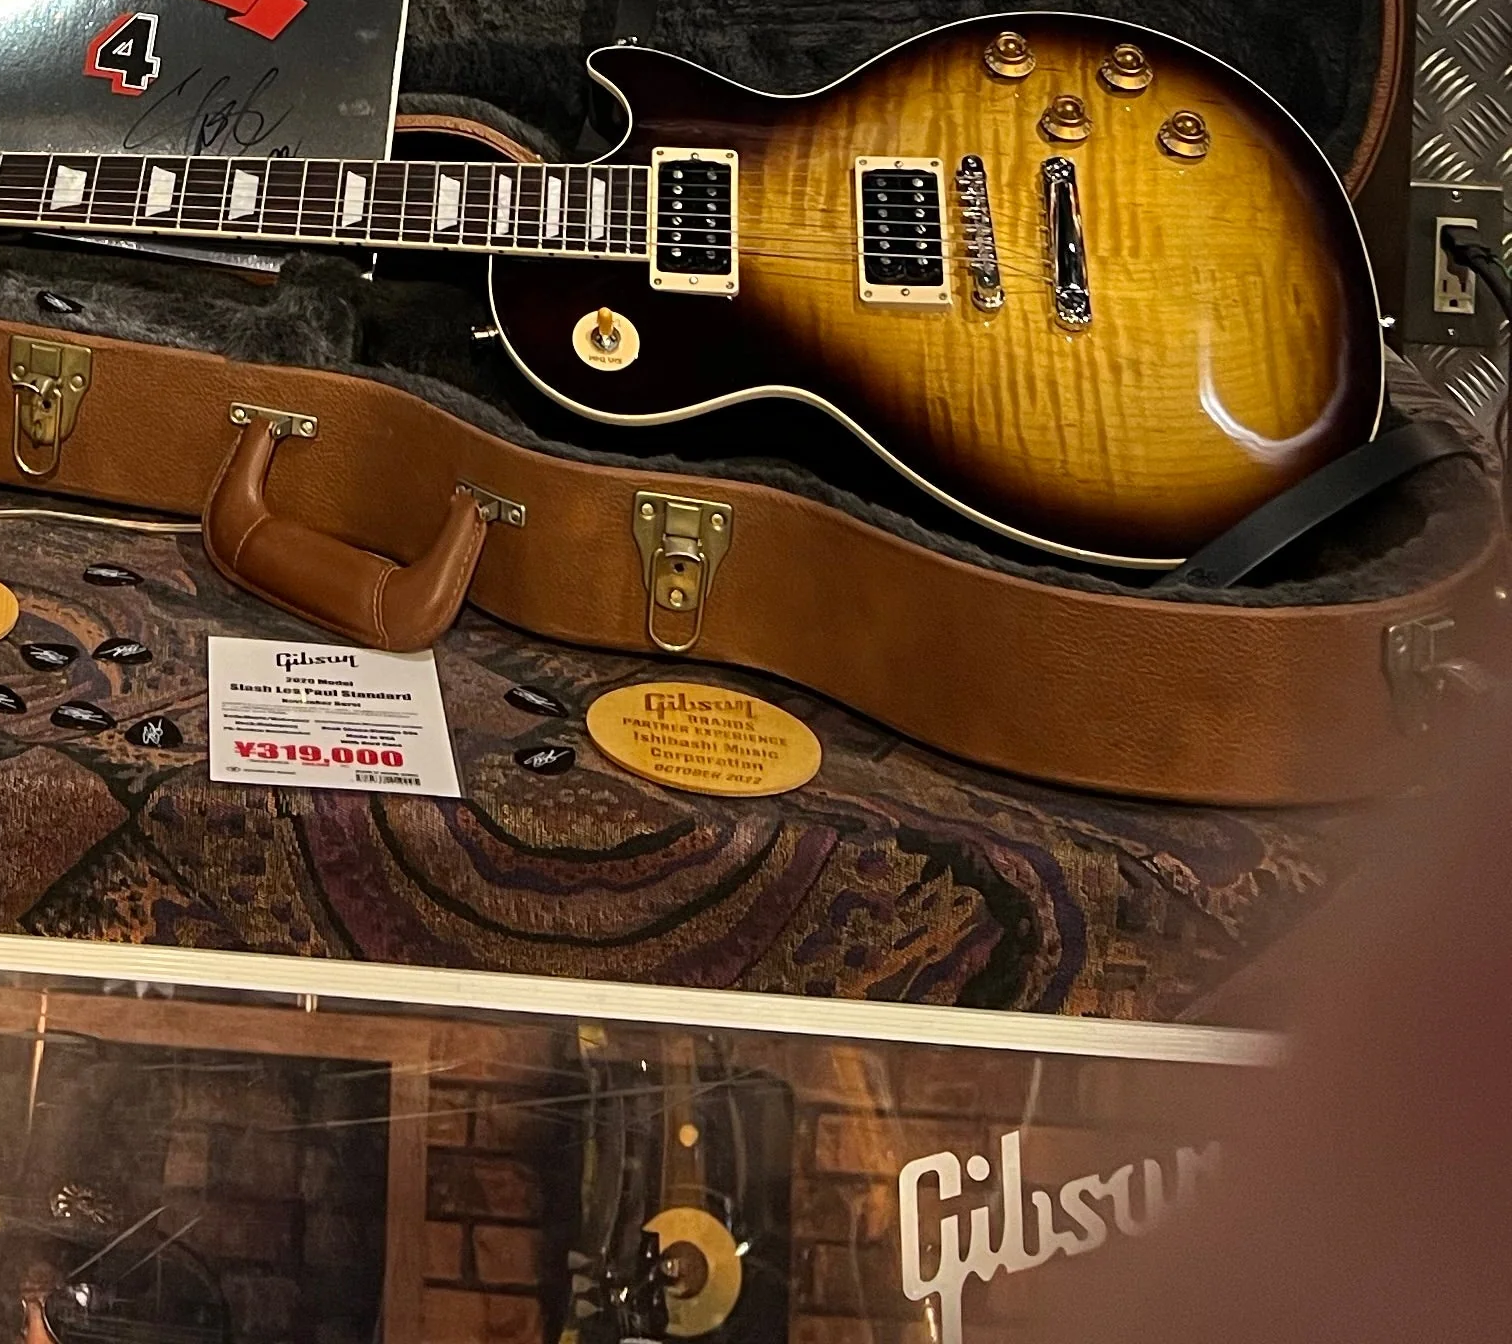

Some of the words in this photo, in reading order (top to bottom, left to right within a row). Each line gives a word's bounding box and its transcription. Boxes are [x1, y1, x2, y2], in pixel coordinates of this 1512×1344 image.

[83, 13, 161, 97] 4
[276, 652, 359, 672] Gibson
[230, 683, 272, 694] Slash
[275, 686, 301, 695] Les
[304, 688, 338, 698] Paul
[341, 690, 412, 701] Standard
[644, 692, 757, 720] Gibson
[622, 717, 689, 734] PARTNER
[694, 726, 788, 747] EXPERIENCE
[688, 714, 755, 732] BRANDS
[234, 740, 404, 767] ¥319,000
[633, 731, 719, 753] Ishibashi
[723, 742, 779, 760] Music
[650, 747, 764, 772] Corporation
[654, 763, 721, 780] OCTOBER
